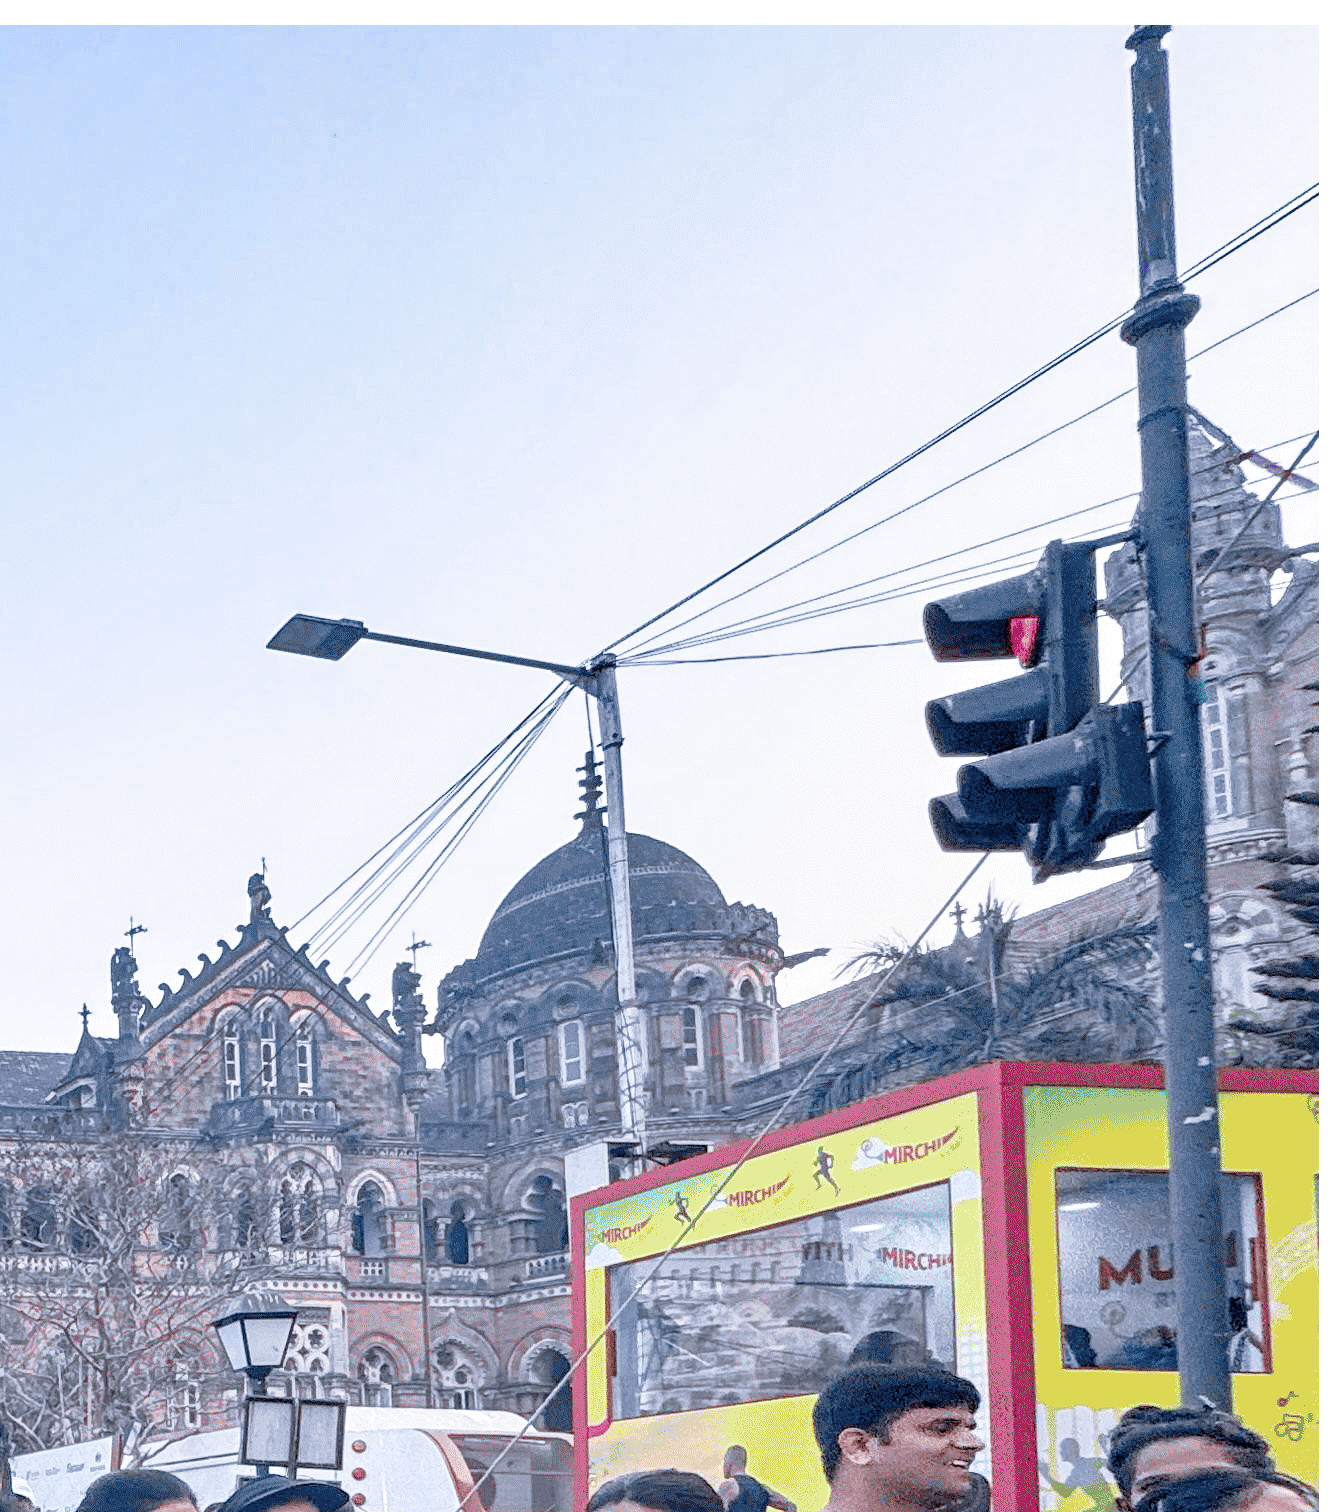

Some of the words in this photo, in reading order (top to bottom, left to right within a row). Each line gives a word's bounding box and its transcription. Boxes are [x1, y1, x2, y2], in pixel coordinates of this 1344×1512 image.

[884, 1134, 954, 1164] MIRCHI
[728, 1180, 786, 1207] MIRCHI
[601, 1217, 649, 1244] MIRCHI
